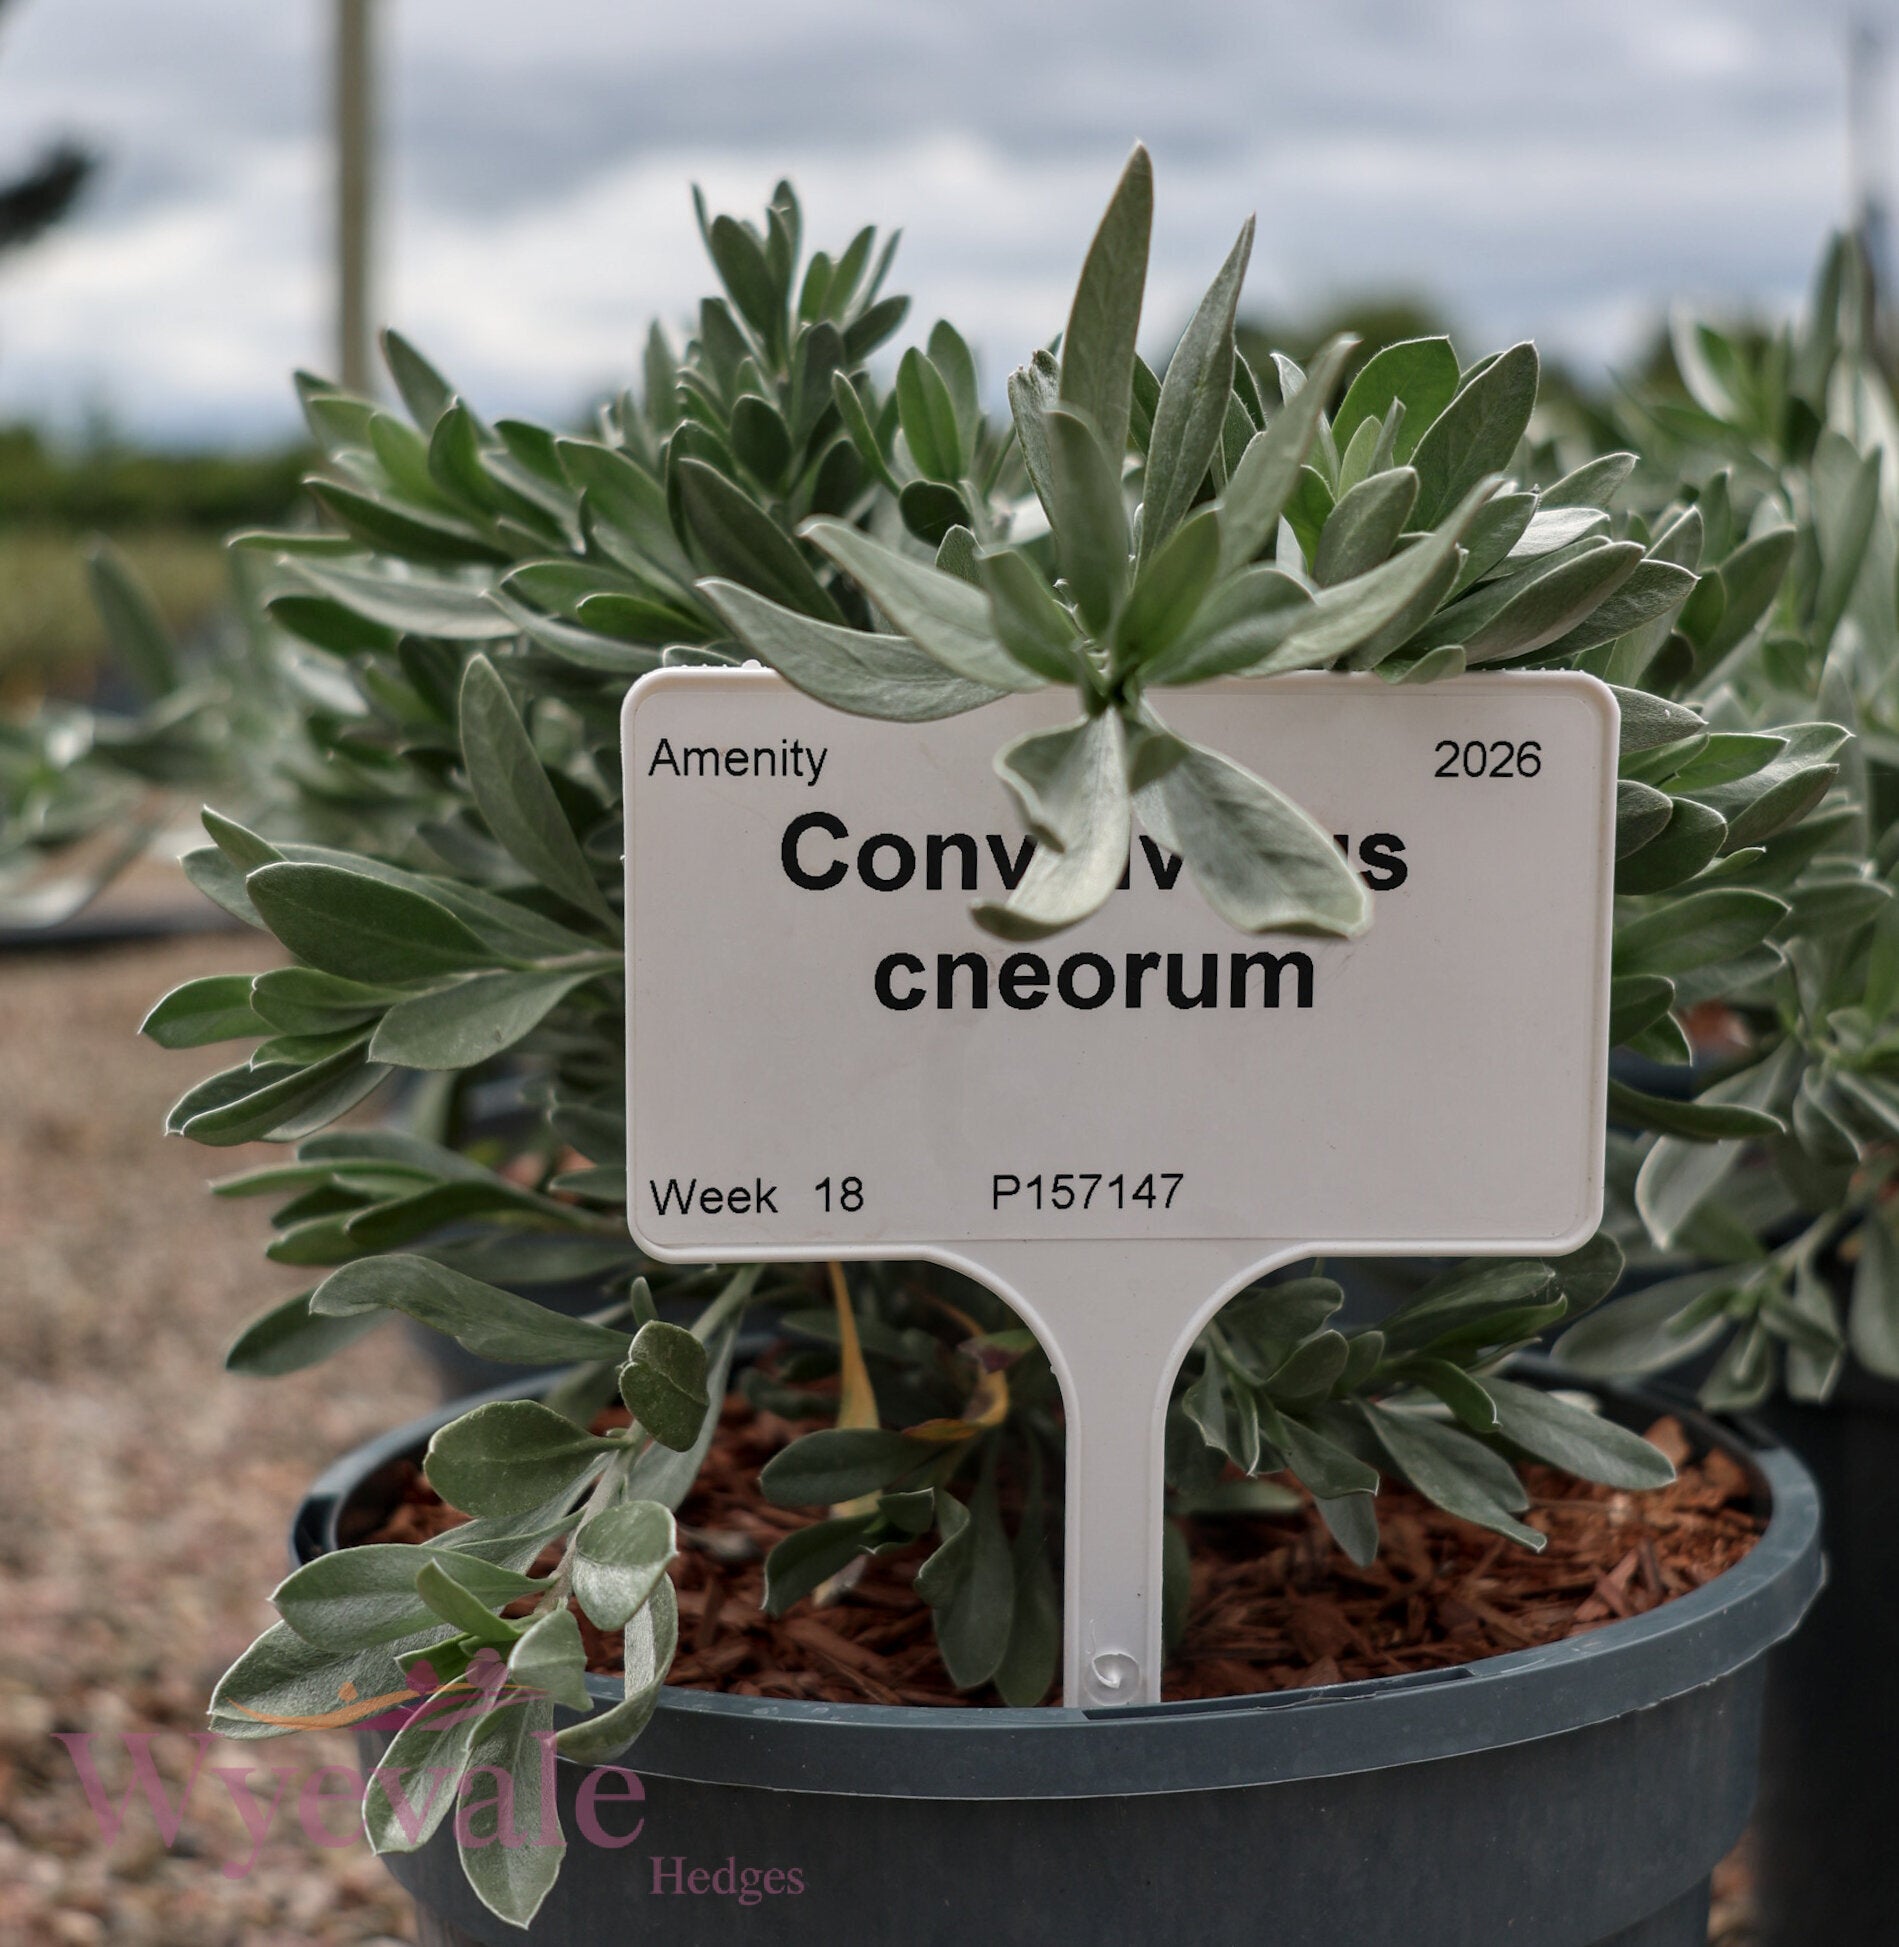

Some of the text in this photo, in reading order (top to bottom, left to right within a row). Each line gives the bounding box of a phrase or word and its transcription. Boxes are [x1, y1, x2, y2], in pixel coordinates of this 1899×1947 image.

[648, 738, 828, 787] Amenity
[1434, 739, 1542, 778] 2026
[780, 811, 1408, 893] Convvs
[874, 951, 1314, 1011] cneorum
[649, 1176, 864, 1216] Week 18
[993, 1173, 1184, 1210] P157147
